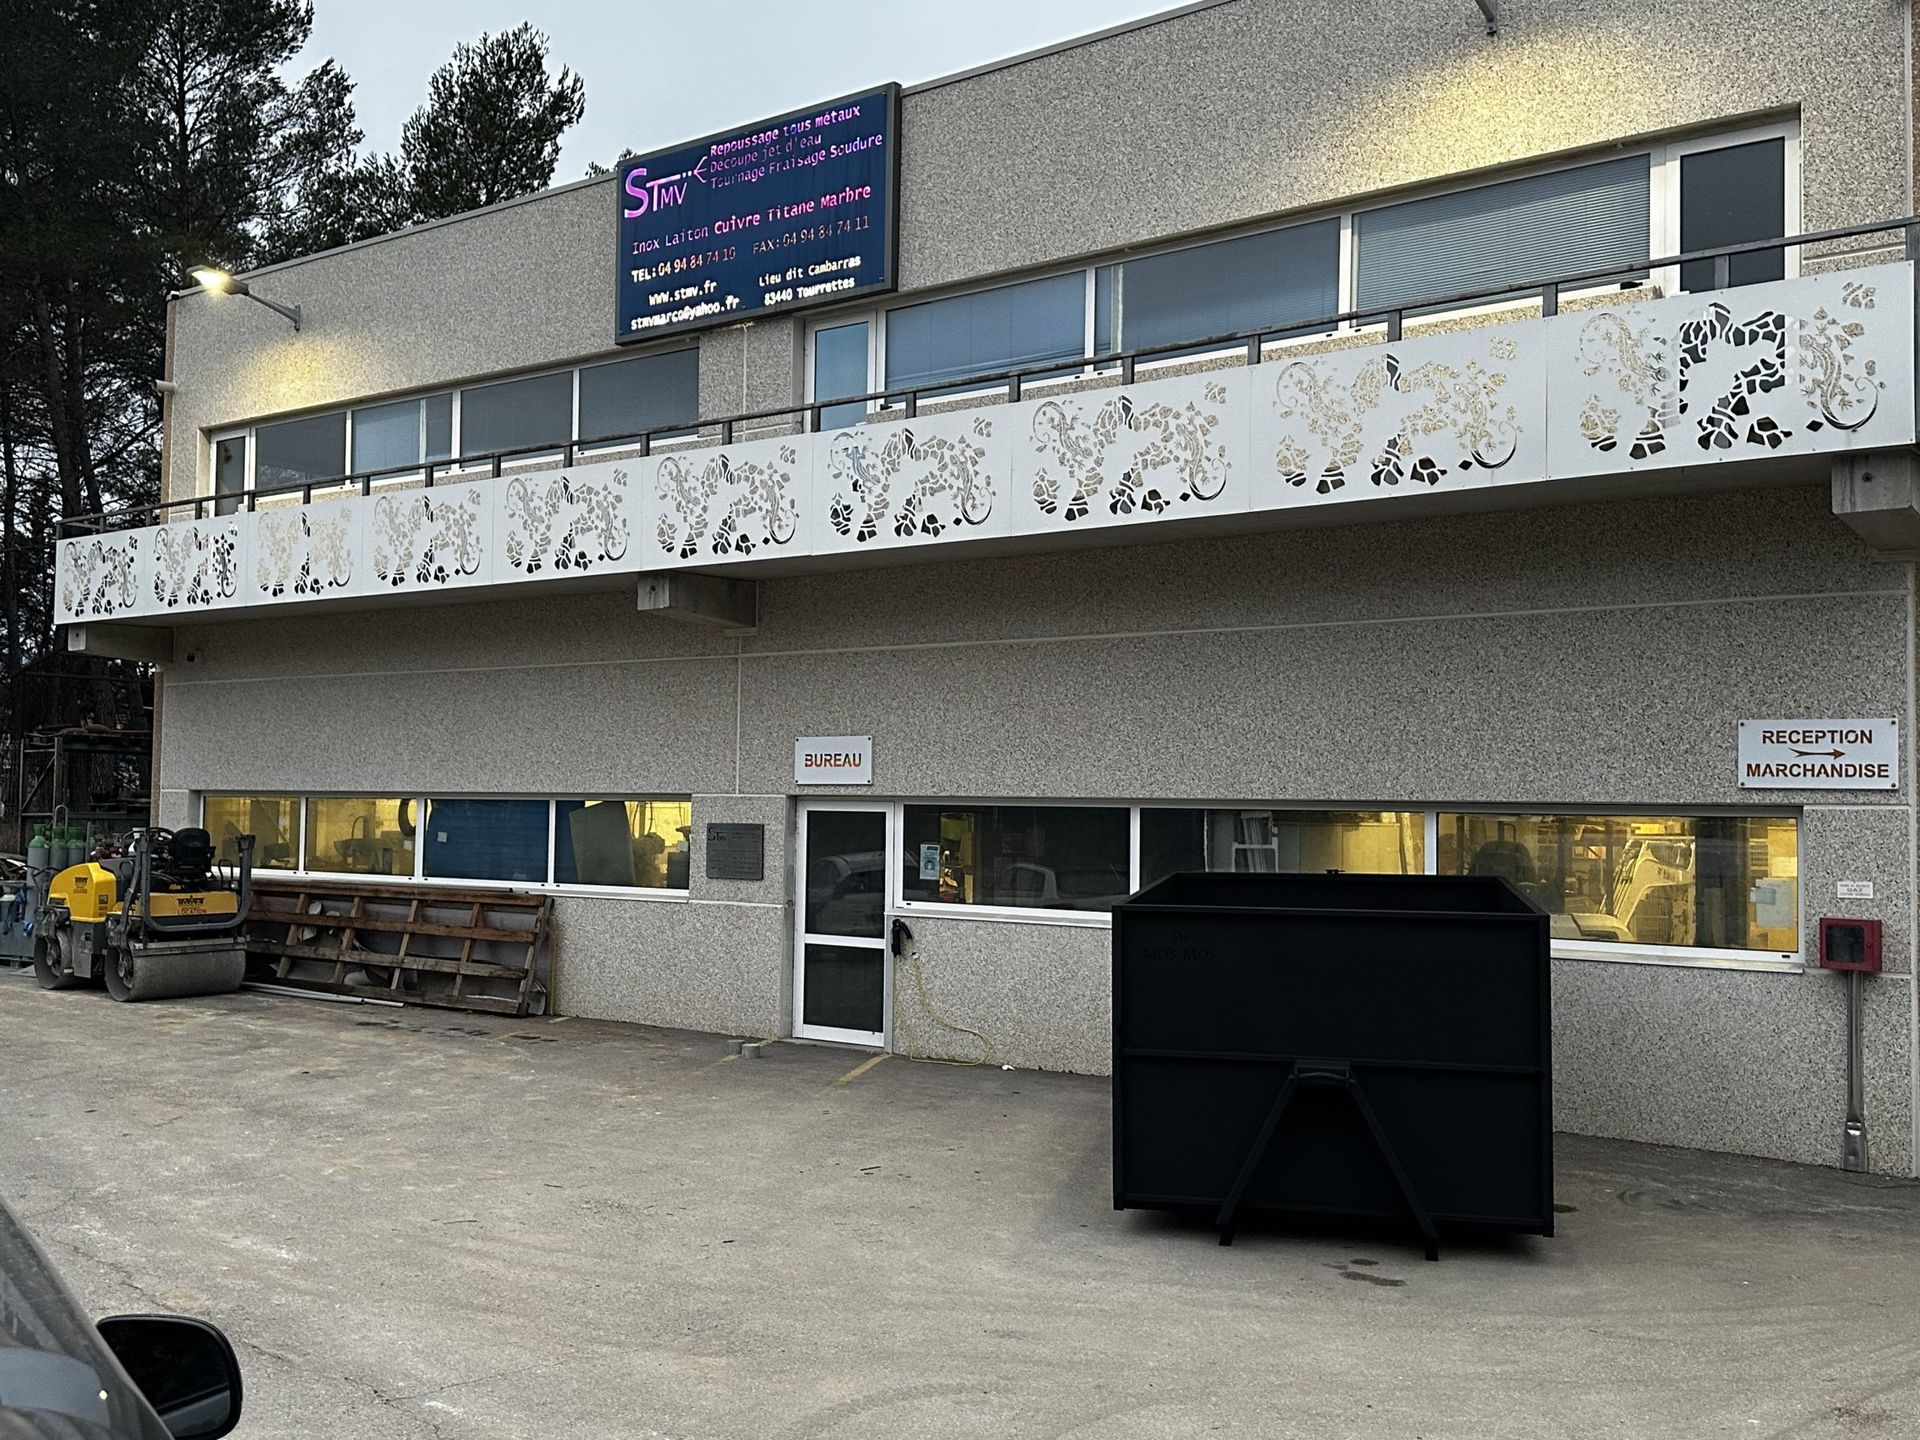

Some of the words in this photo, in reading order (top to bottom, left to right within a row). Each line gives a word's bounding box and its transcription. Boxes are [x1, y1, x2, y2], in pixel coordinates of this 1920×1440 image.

[710, 129, 779, 156] Repoussage
[783, 119, 811, 137] tous
[815, 105, 860, 127] métaux
[711, 166, 765, 188] Tournage
[769, 149, 826, 175] Fraisage
[830, 134, 883, 158] Soudure
[762, 145, 781, 162] jet
[785, 134, 822, 153] d'eau
[632, 238, 660, 255] Inox
[665, 227, 708, 246] Laiton
[714, 213, 760, 234] Cuivre
[767, 201, 814, 222] Titane
[820, 185, 871, 208] Marbre
[800, 228, 814, 243] 94
[818, 224, 832, 239] 84
[837, 220, 851, 235] 74
[855, 215, 869, 231] 11
[673, 257, 687, 274] 94
[689, 254, 703, 269] 84
[706, 248, 719, 265] 74
[722, 246, 736, 261] 10
[759, 273, 782, 287] Lieu
[786, 267, 804, 282] dit
[808, 255, 861, 276] Cambarras
[764, 288, 793, 306] 83440
[797, 277, 855, 299] Tourrettes
[1762, 729, 1873, 744] RECEPTION
[804, 753, 862, 768] BUREAU
[1746, 763, 1890, 778] MARCHANDISE
